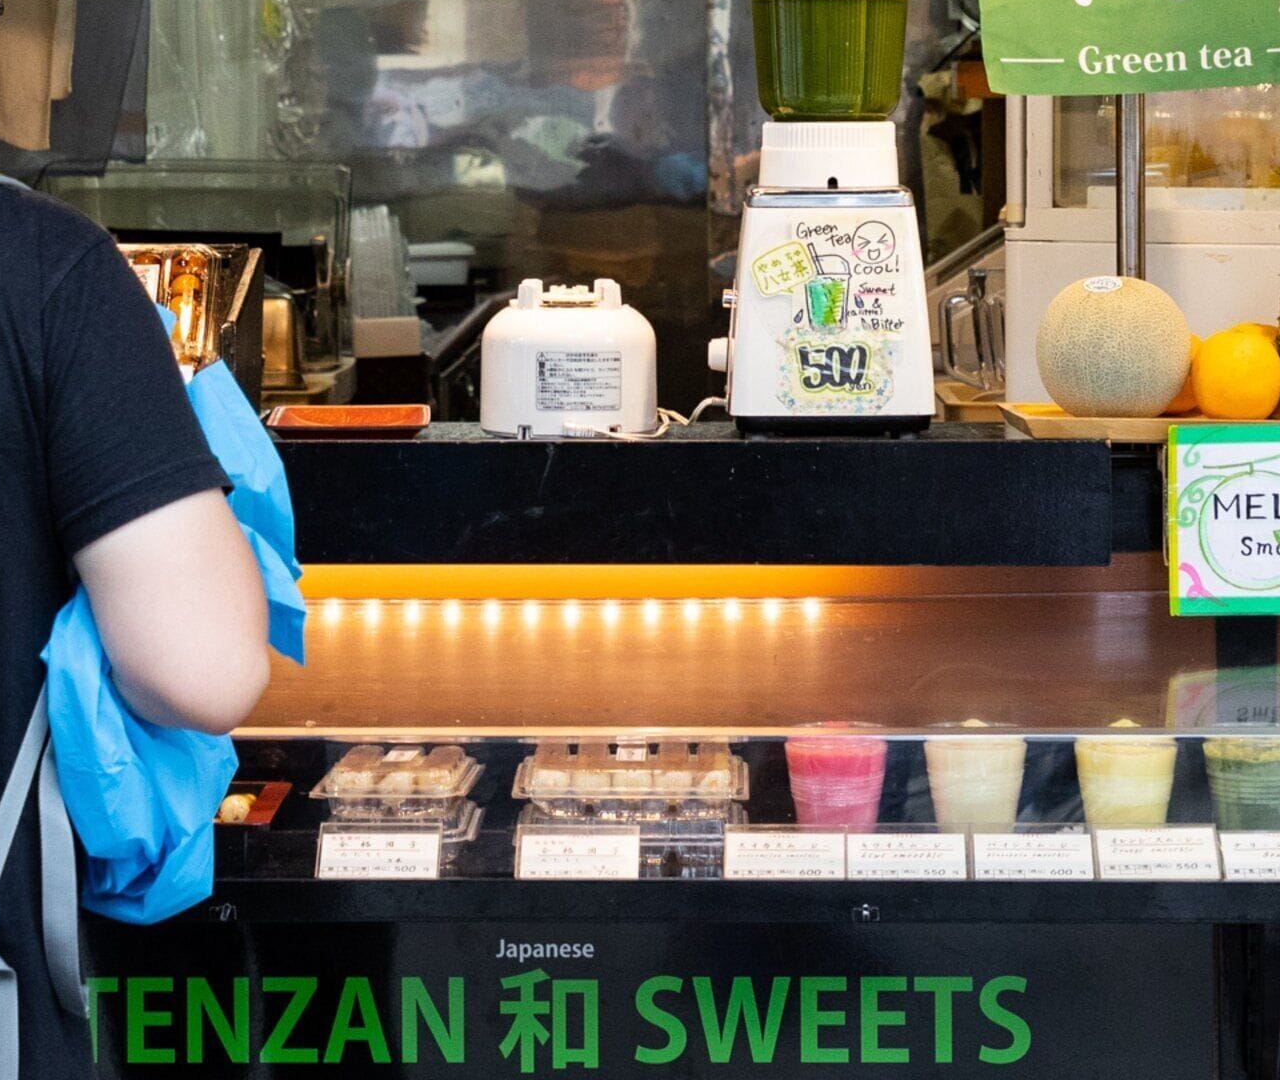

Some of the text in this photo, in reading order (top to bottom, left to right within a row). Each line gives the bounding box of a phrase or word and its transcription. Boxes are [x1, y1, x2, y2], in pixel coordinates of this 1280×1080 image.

[1078, 41, 1254, 75] Green tea
[796, 221, 839, 240] Green
[798, 344, 868, 390] 500
[495, 938, 596, 964] Japanese
[87, 976, 466, 1064] TENZAN
[499, 969, 601, 1074] 和
[634, 975, 1032, 1065] SWEETS
